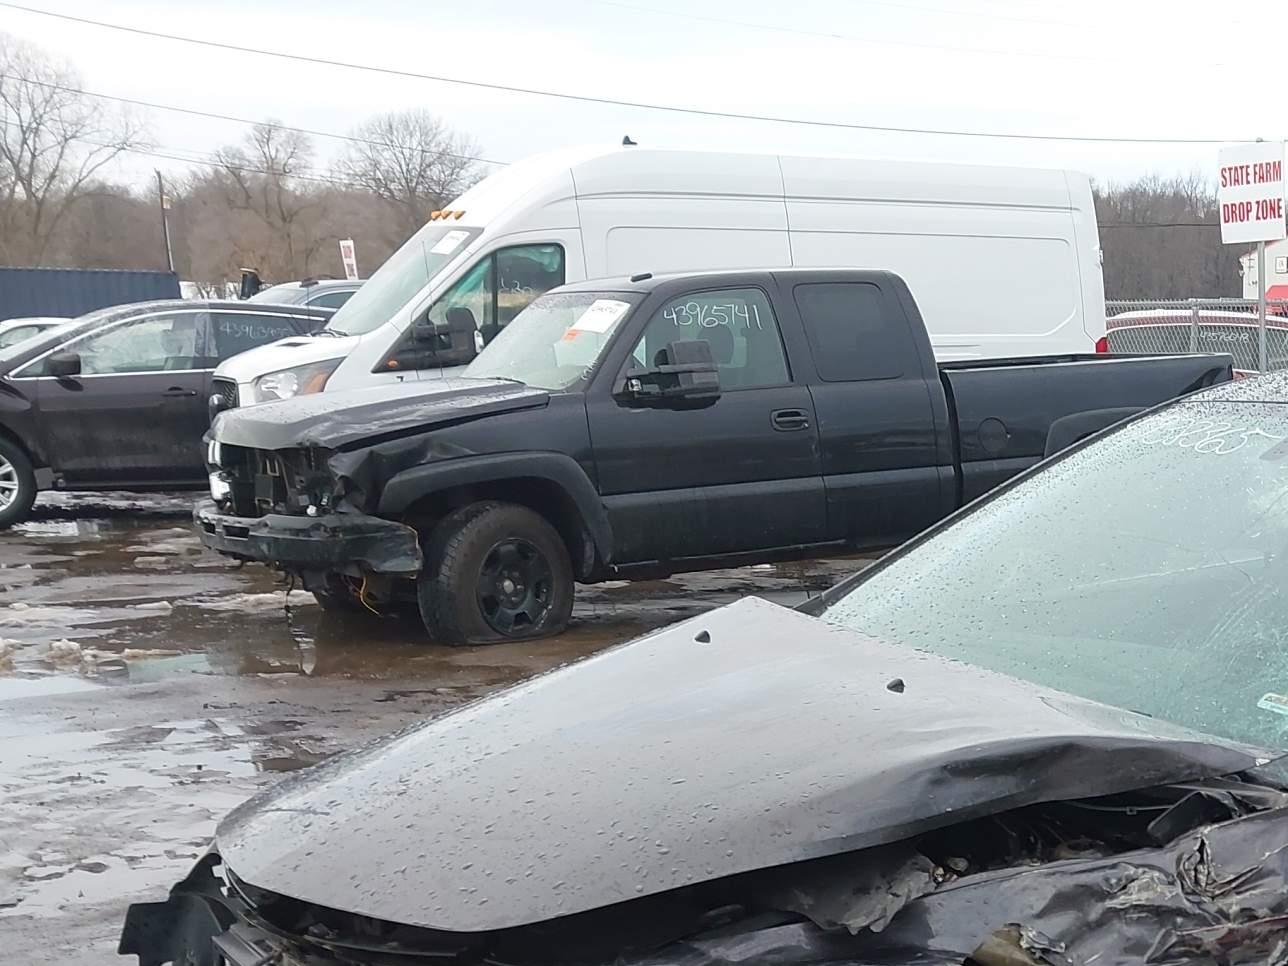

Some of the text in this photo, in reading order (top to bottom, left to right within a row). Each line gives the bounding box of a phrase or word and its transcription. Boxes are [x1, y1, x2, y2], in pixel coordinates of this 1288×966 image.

[1221, 160, 1282, 188] STATE FARM
[1223, 198, 1283, 224] DROP ZONE
[663, 302, 763, 330] 43965741
